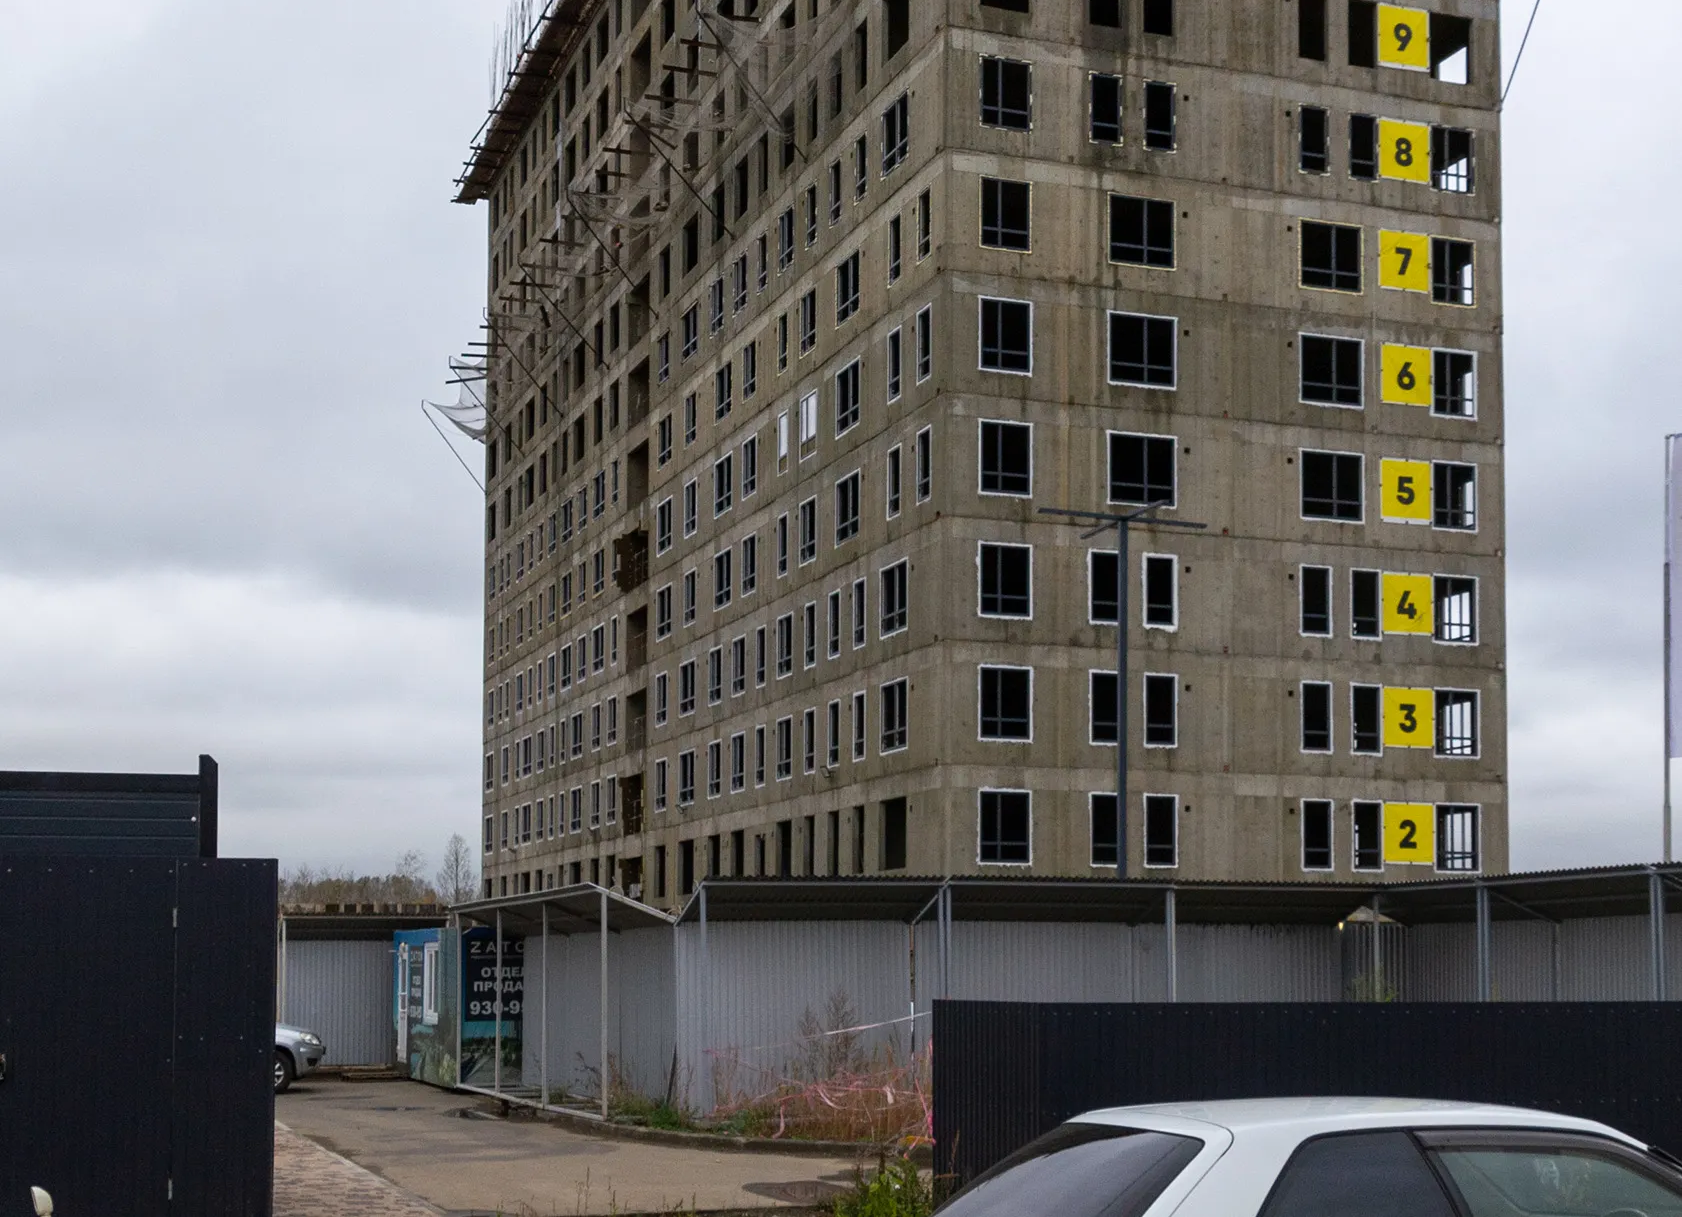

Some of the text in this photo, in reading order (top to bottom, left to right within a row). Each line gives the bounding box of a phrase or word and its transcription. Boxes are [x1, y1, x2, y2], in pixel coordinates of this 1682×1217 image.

[1393, 22, 1413, 52] 9
[1394, 137, 1413, 168] 8
[1395, 246, 1413, 276] 7
[1396, 361, 1416, 391] 6
[1396, 475, 1416, 506] 5
[1396, 590, 1418, 620] 4
[1398, 703, 1418, 734] 3
[1398, 819, 1418, 850] 2
[469, 1000, 524, 1015] 930-9
